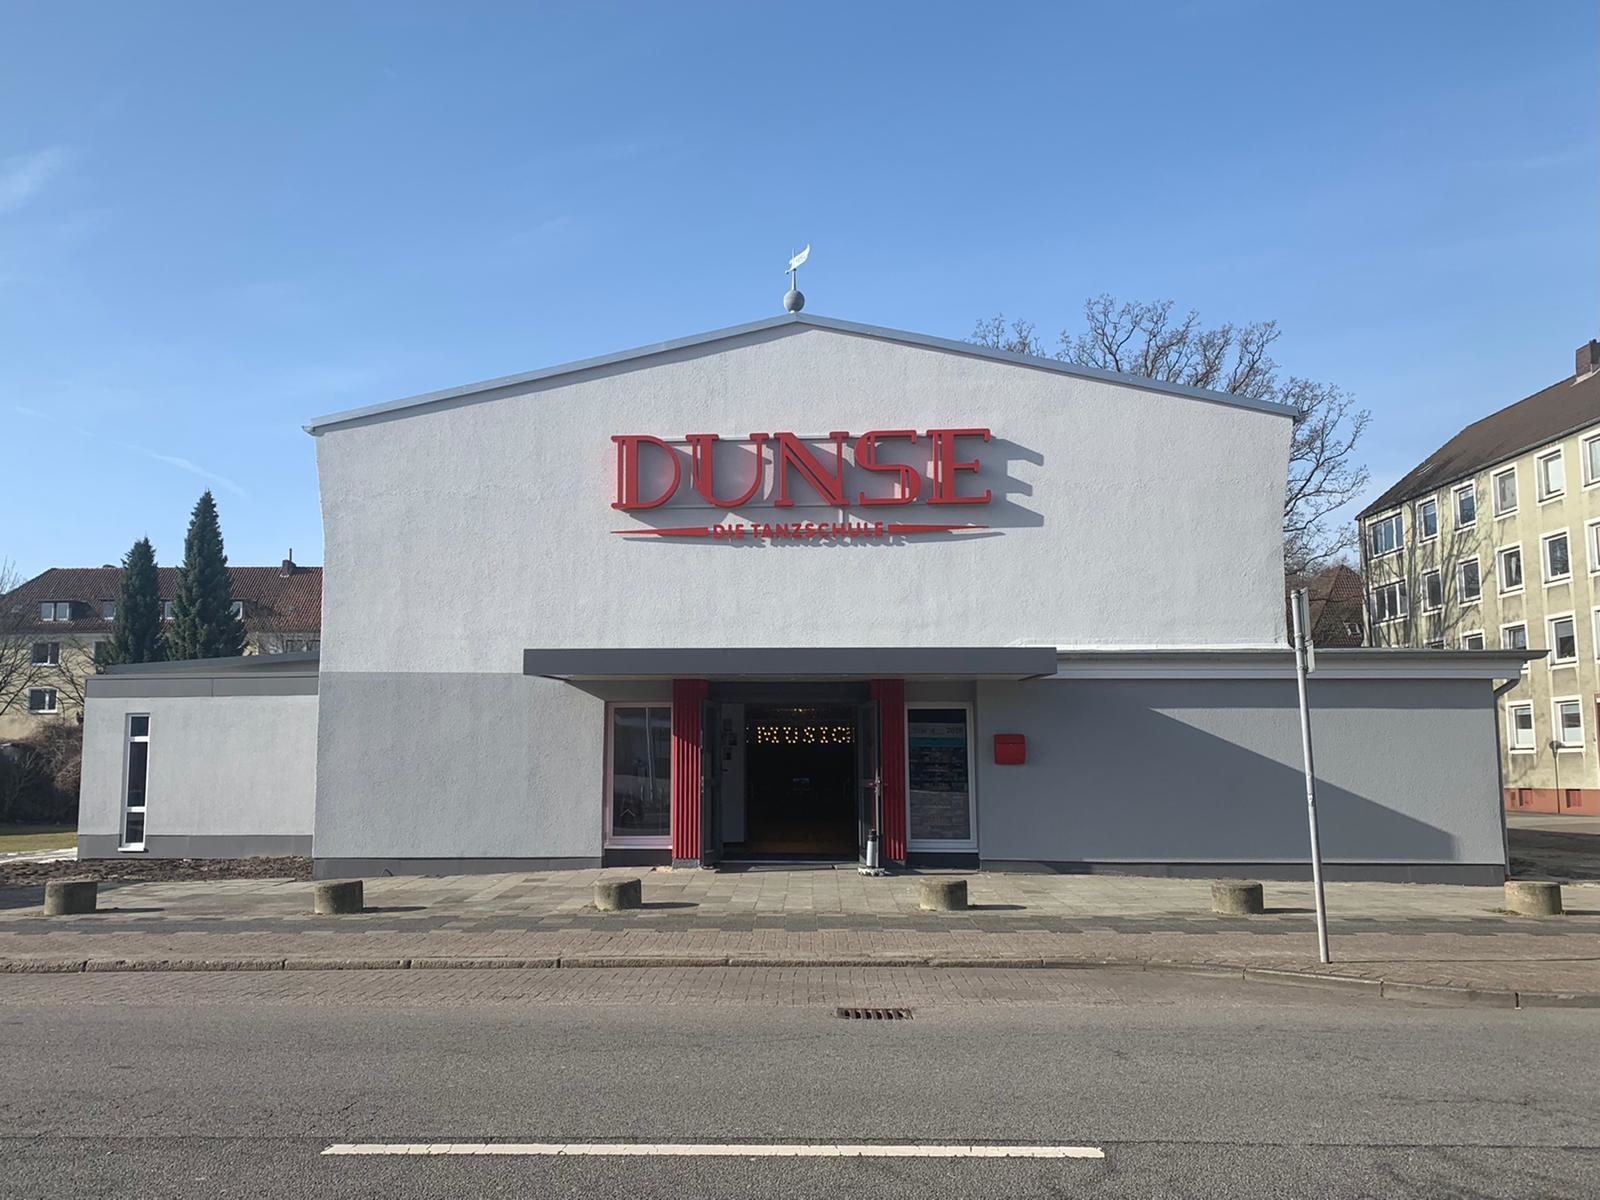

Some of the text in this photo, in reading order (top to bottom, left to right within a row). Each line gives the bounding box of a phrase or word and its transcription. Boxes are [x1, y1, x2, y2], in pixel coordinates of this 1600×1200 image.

[611, 428, 991, 509] DUNSE
[712, 521, 884, 539] DIE TANZSCHULE
